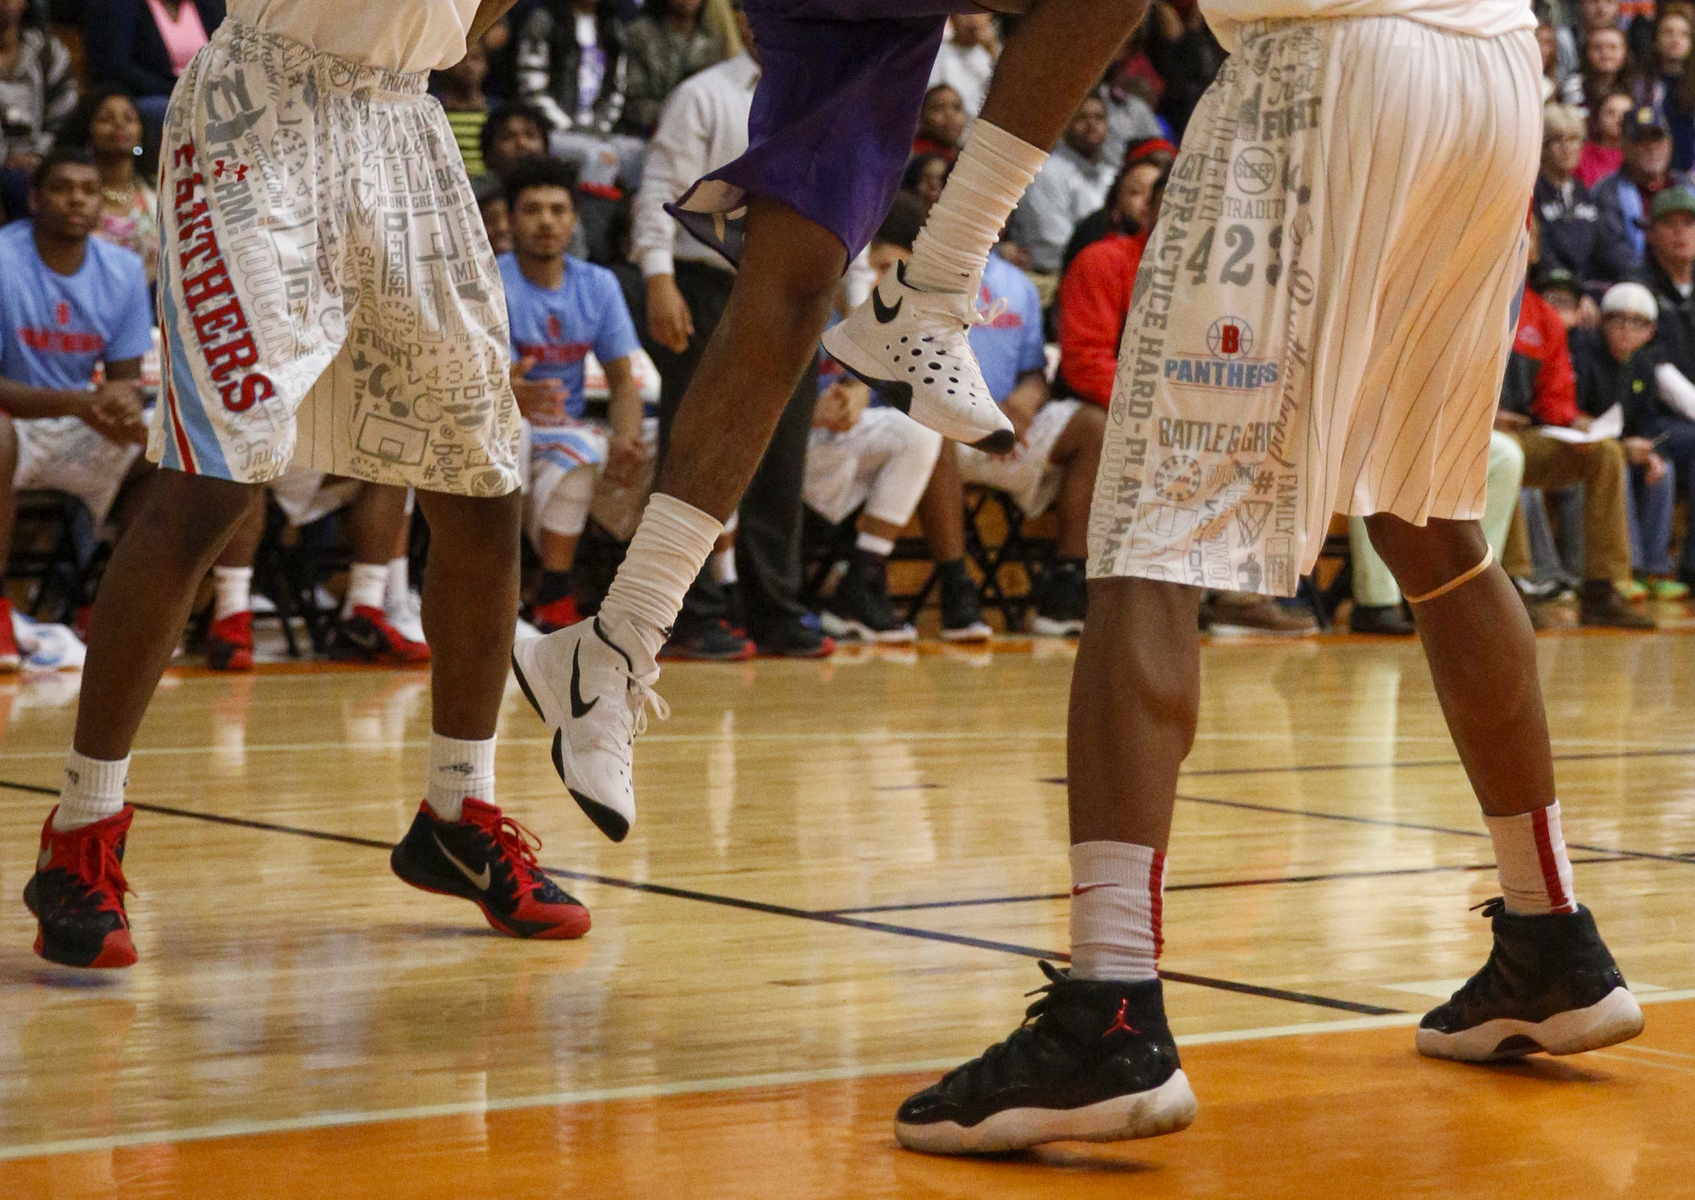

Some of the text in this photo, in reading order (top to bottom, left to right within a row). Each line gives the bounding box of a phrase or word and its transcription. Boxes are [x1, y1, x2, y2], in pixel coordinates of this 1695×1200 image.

[389, 195, 409, 208] ONE
[383, 211, 411, 298] D-FENSE
[1142, 184, 1201, 331] PRACTICE
[1221, 323, 1241, 354] B
[1158, 416, 1228, 453] BATTLE
[1275, 473, 1298, 536] FAMILY
[1097, 516, 1133, 576] HAR
